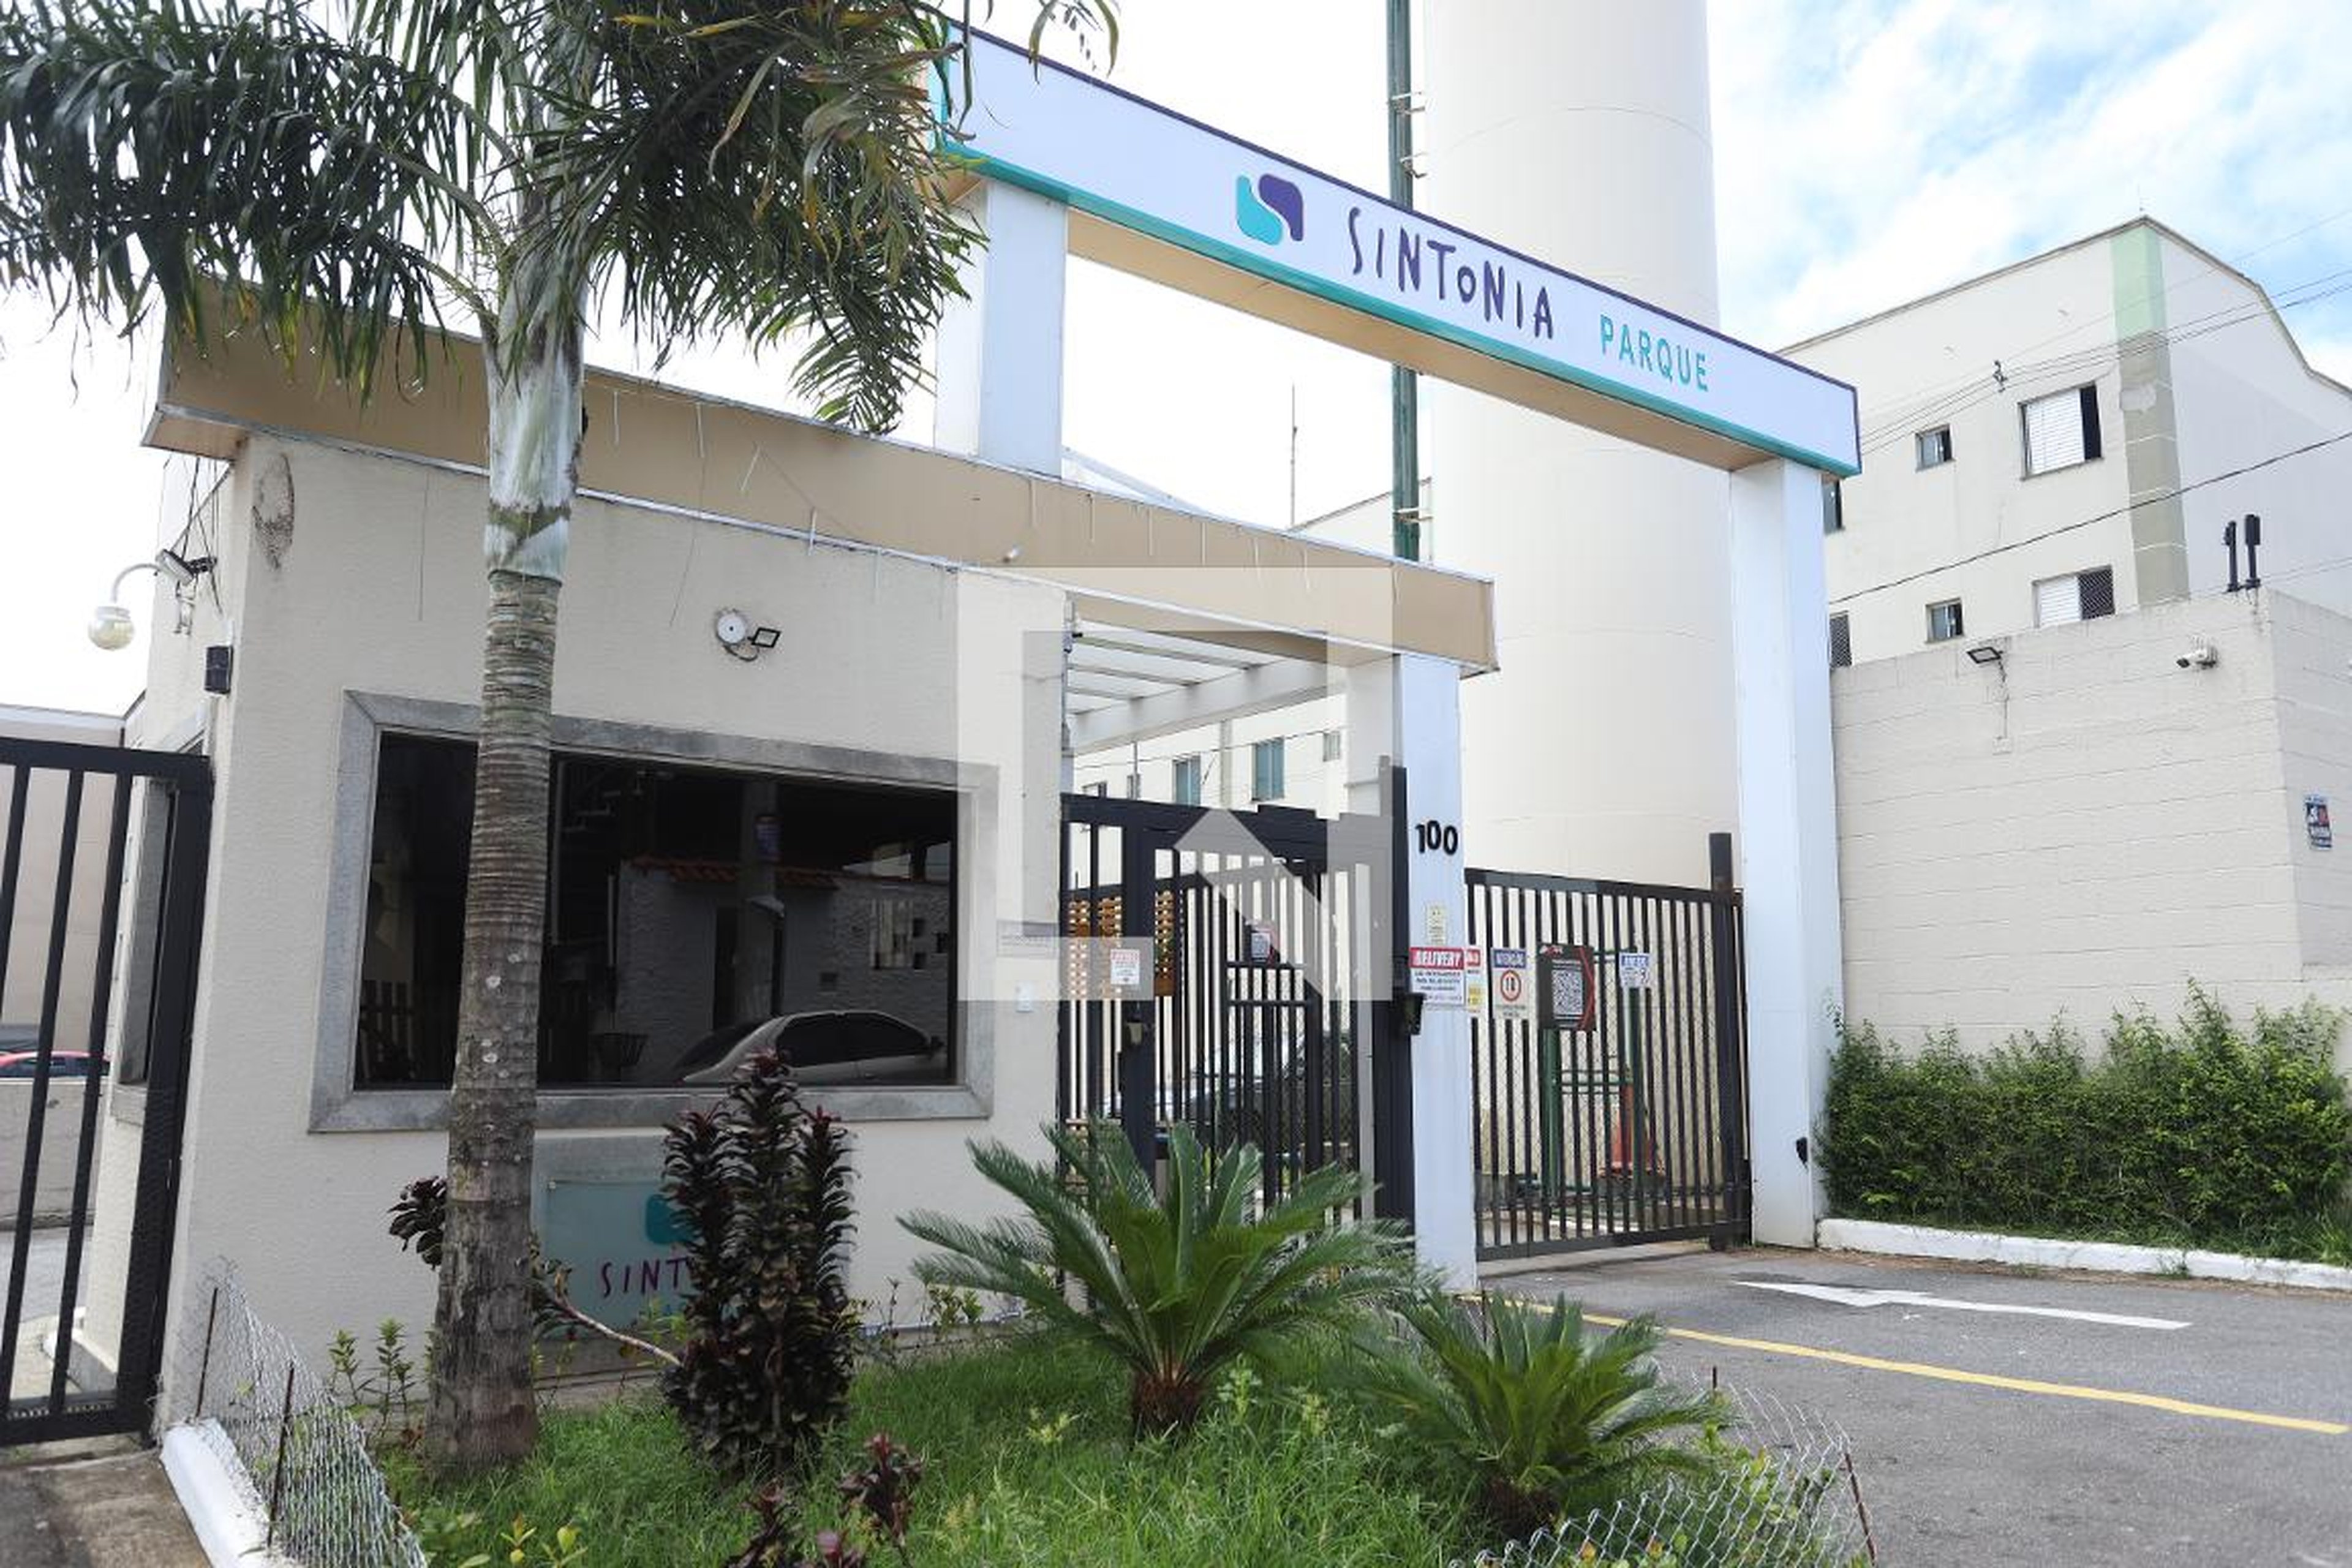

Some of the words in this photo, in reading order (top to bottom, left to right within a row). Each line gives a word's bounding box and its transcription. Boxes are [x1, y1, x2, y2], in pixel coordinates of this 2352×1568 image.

[1347, 207, 1555, 339] SINTONIA
[1600, 314, 1709, 393] PARQUE
[1415, 820, 1458, 856] 100
[601, 1257, 688, 1298] SINT
